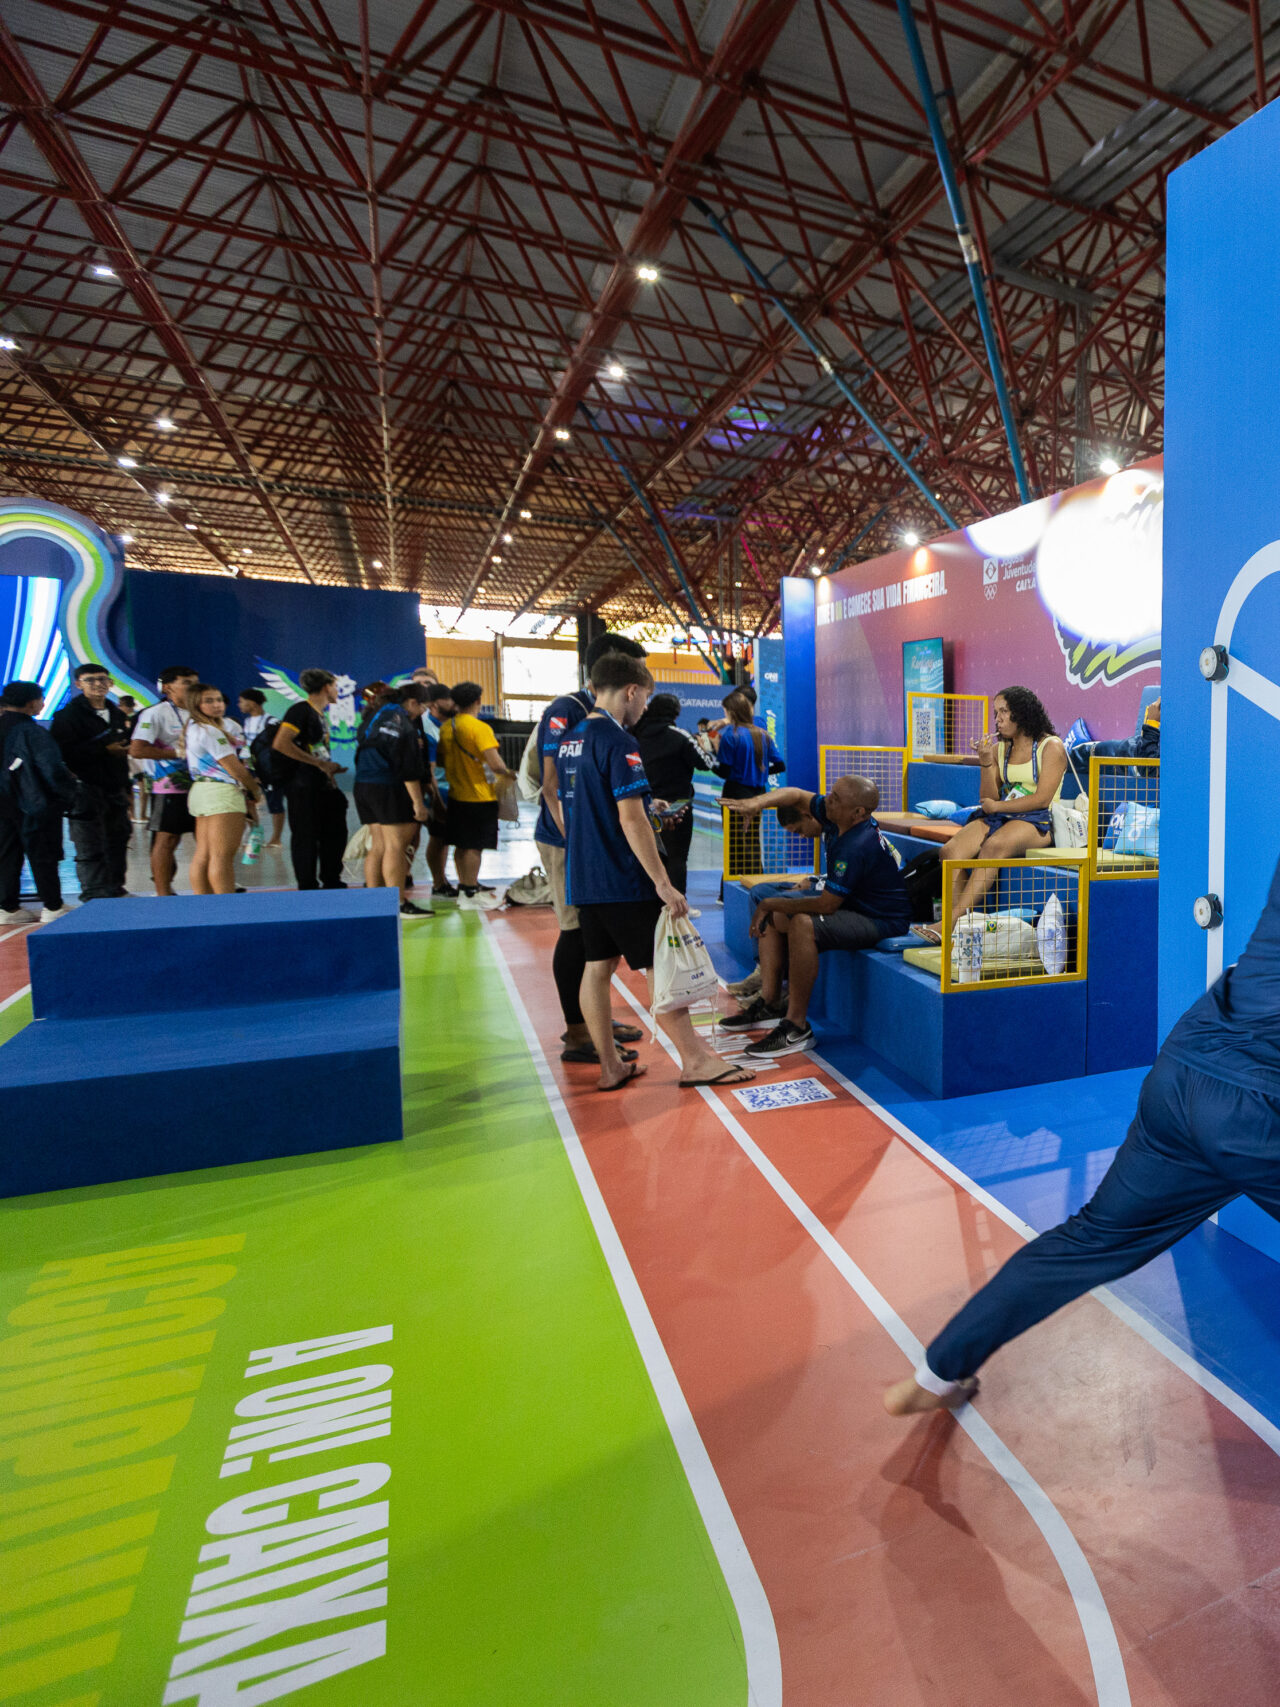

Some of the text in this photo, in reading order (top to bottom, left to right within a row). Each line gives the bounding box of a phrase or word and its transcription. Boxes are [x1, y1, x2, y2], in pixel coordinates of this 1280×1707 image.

[885, 582, 902, 609] VIDA
[902, 569, 948, 606] FINANCEIRA.
[162, 1323, 394, 1707] A ON! CAIXA
